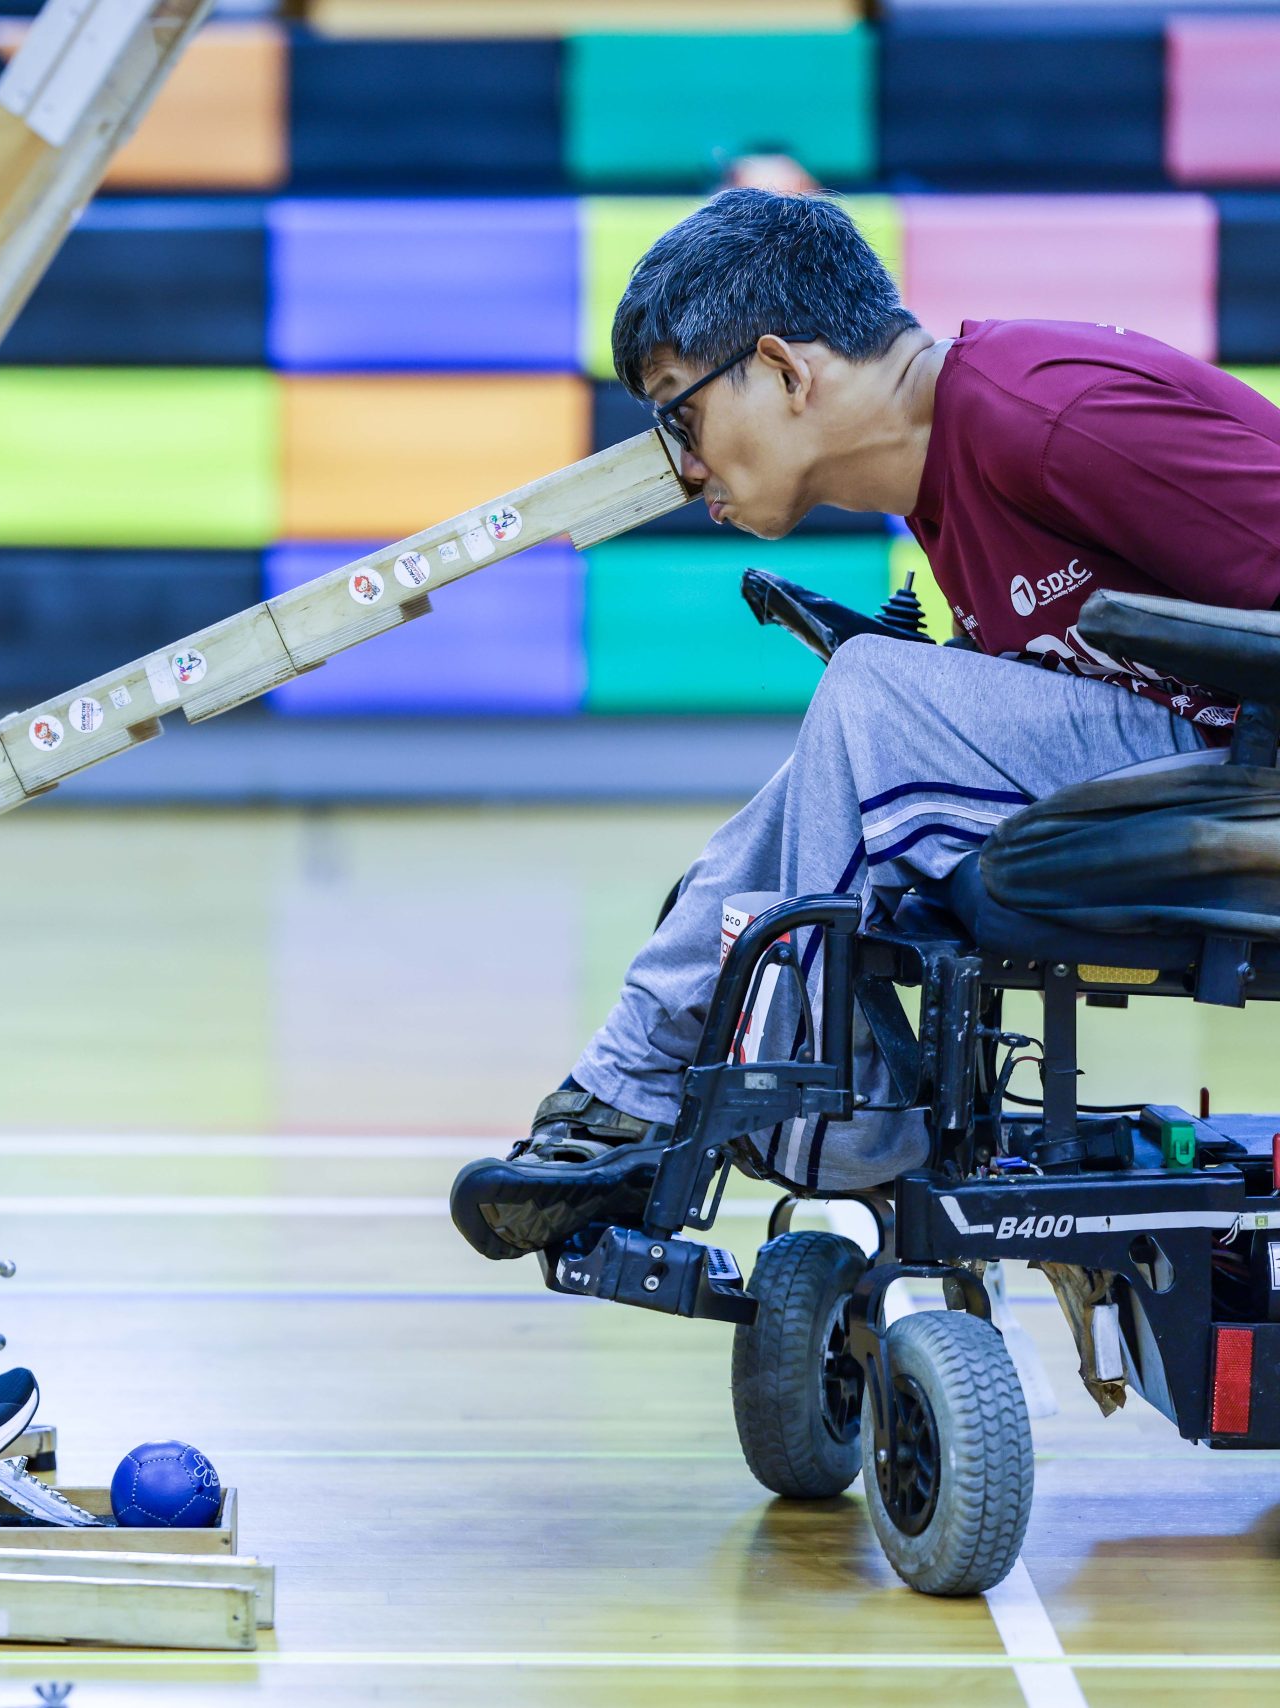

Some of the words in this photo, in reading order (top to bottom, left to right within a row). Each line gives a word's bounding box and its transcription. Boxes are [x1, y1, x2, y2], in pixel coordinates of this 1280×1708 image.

[1036, 558, 1087, 598] SDSC
[723, 914, 741, 927] OCO
[995, 1214, 1075, 1240] B400
